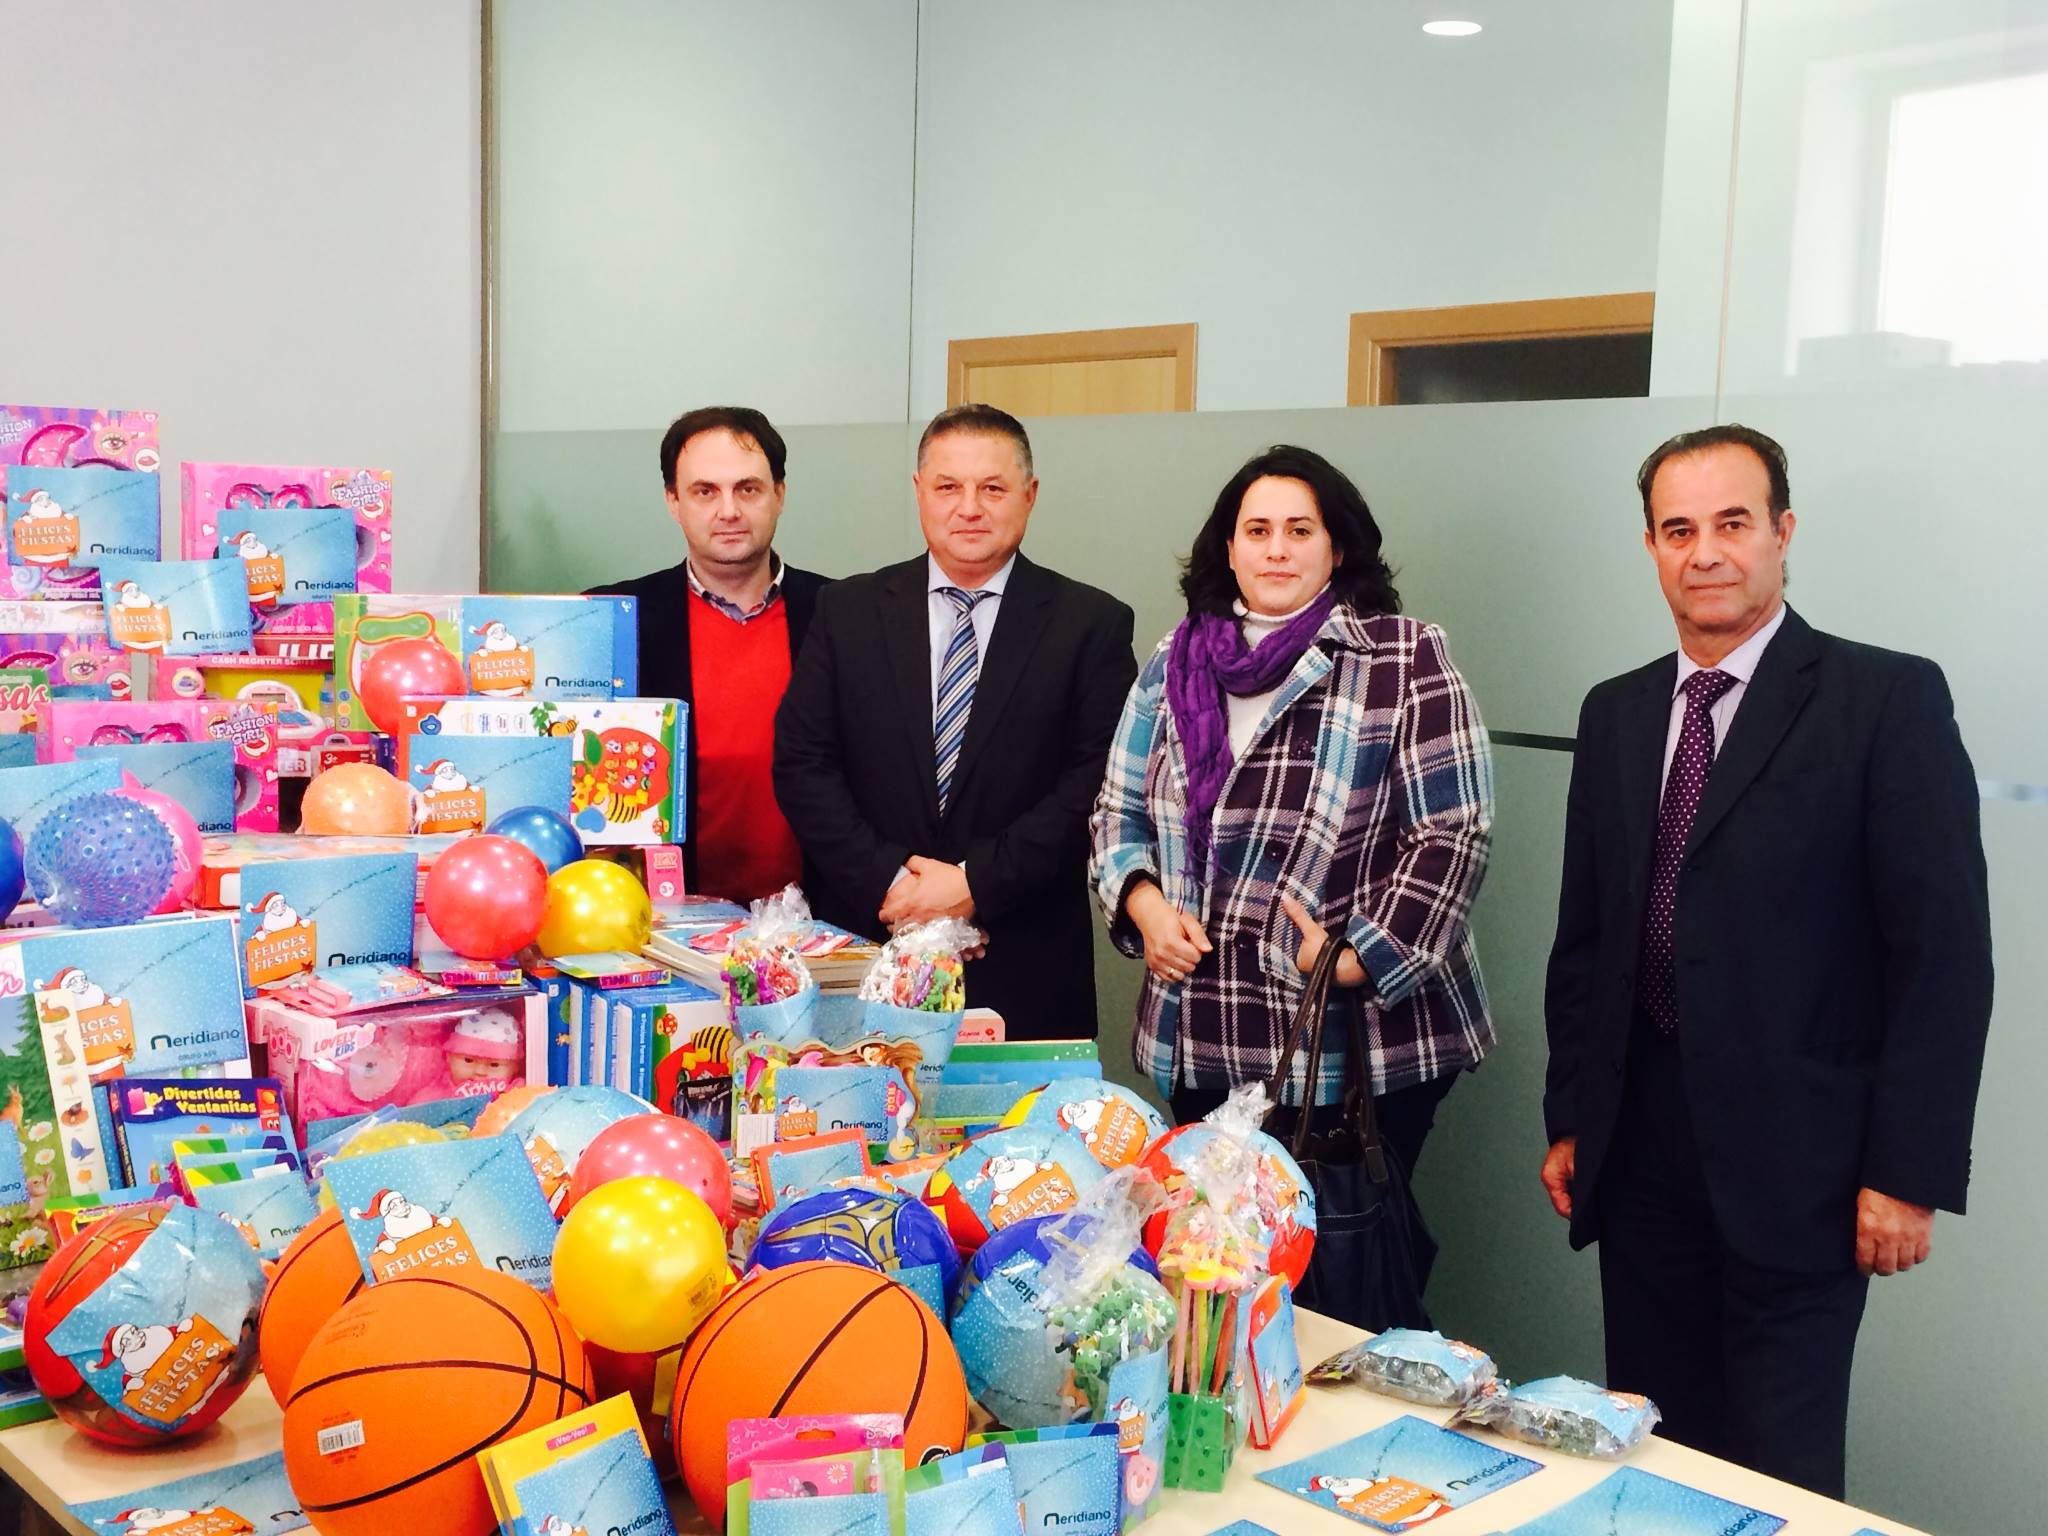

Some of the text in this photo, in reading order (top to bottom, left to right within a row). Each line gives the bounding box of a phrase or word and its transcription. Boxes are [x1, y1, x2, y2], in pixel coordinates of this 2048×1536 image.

[211, 656, 237, 664] CASH
[238, 656, 283, 665] REGISTER
[215, 714, 274, 739] FASHION
[231, 728, 265, 745] GIRL
[314, 1029, 357, 1053] LOVELY
[334, 1042, 356, 1058] KIDS
[163, 1087, 241, 1101] Divertidas
[175, 1101, 257, 1114] Ventanitas
